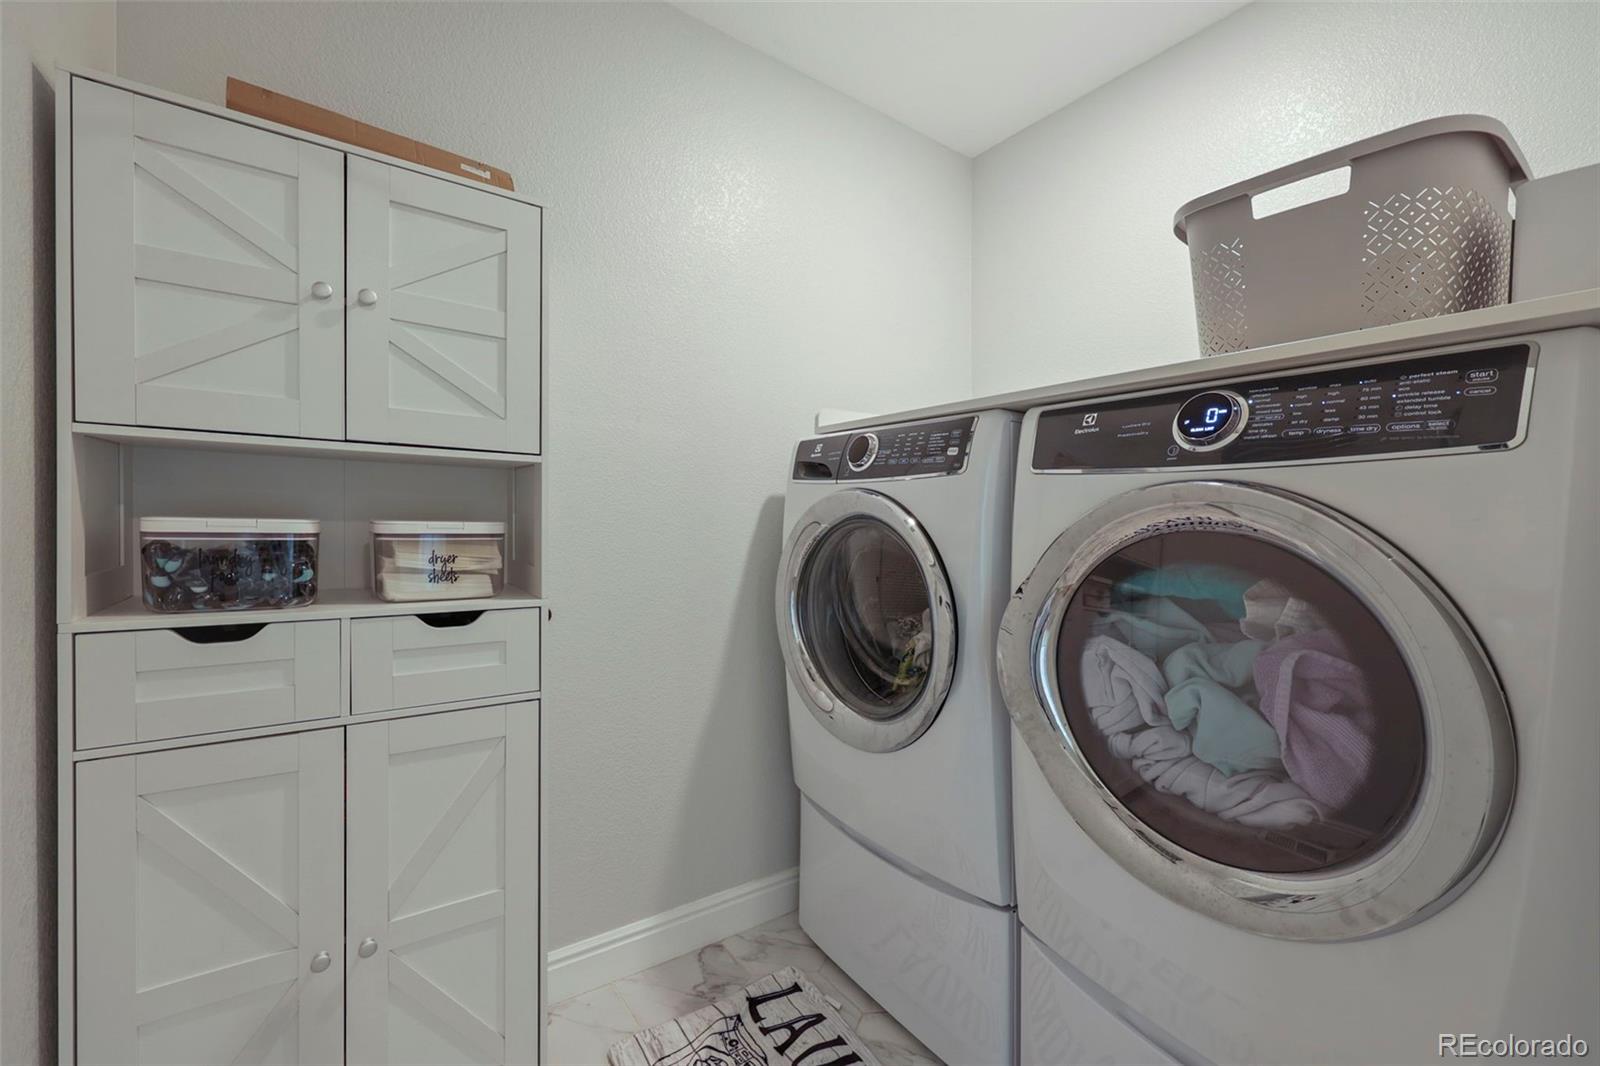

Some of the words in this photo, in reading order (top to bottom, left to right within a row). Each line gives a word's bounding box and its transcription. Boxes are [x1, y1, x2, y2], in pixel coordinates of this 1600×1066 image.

[1470, 370, 1493, 378] start
[1205, 407, 1219, 424] 0
[1074, 427, 1100, 435] Electrolux
[428, 549, 458, 574] dryer
[428, 567, 460, 584] sheets
